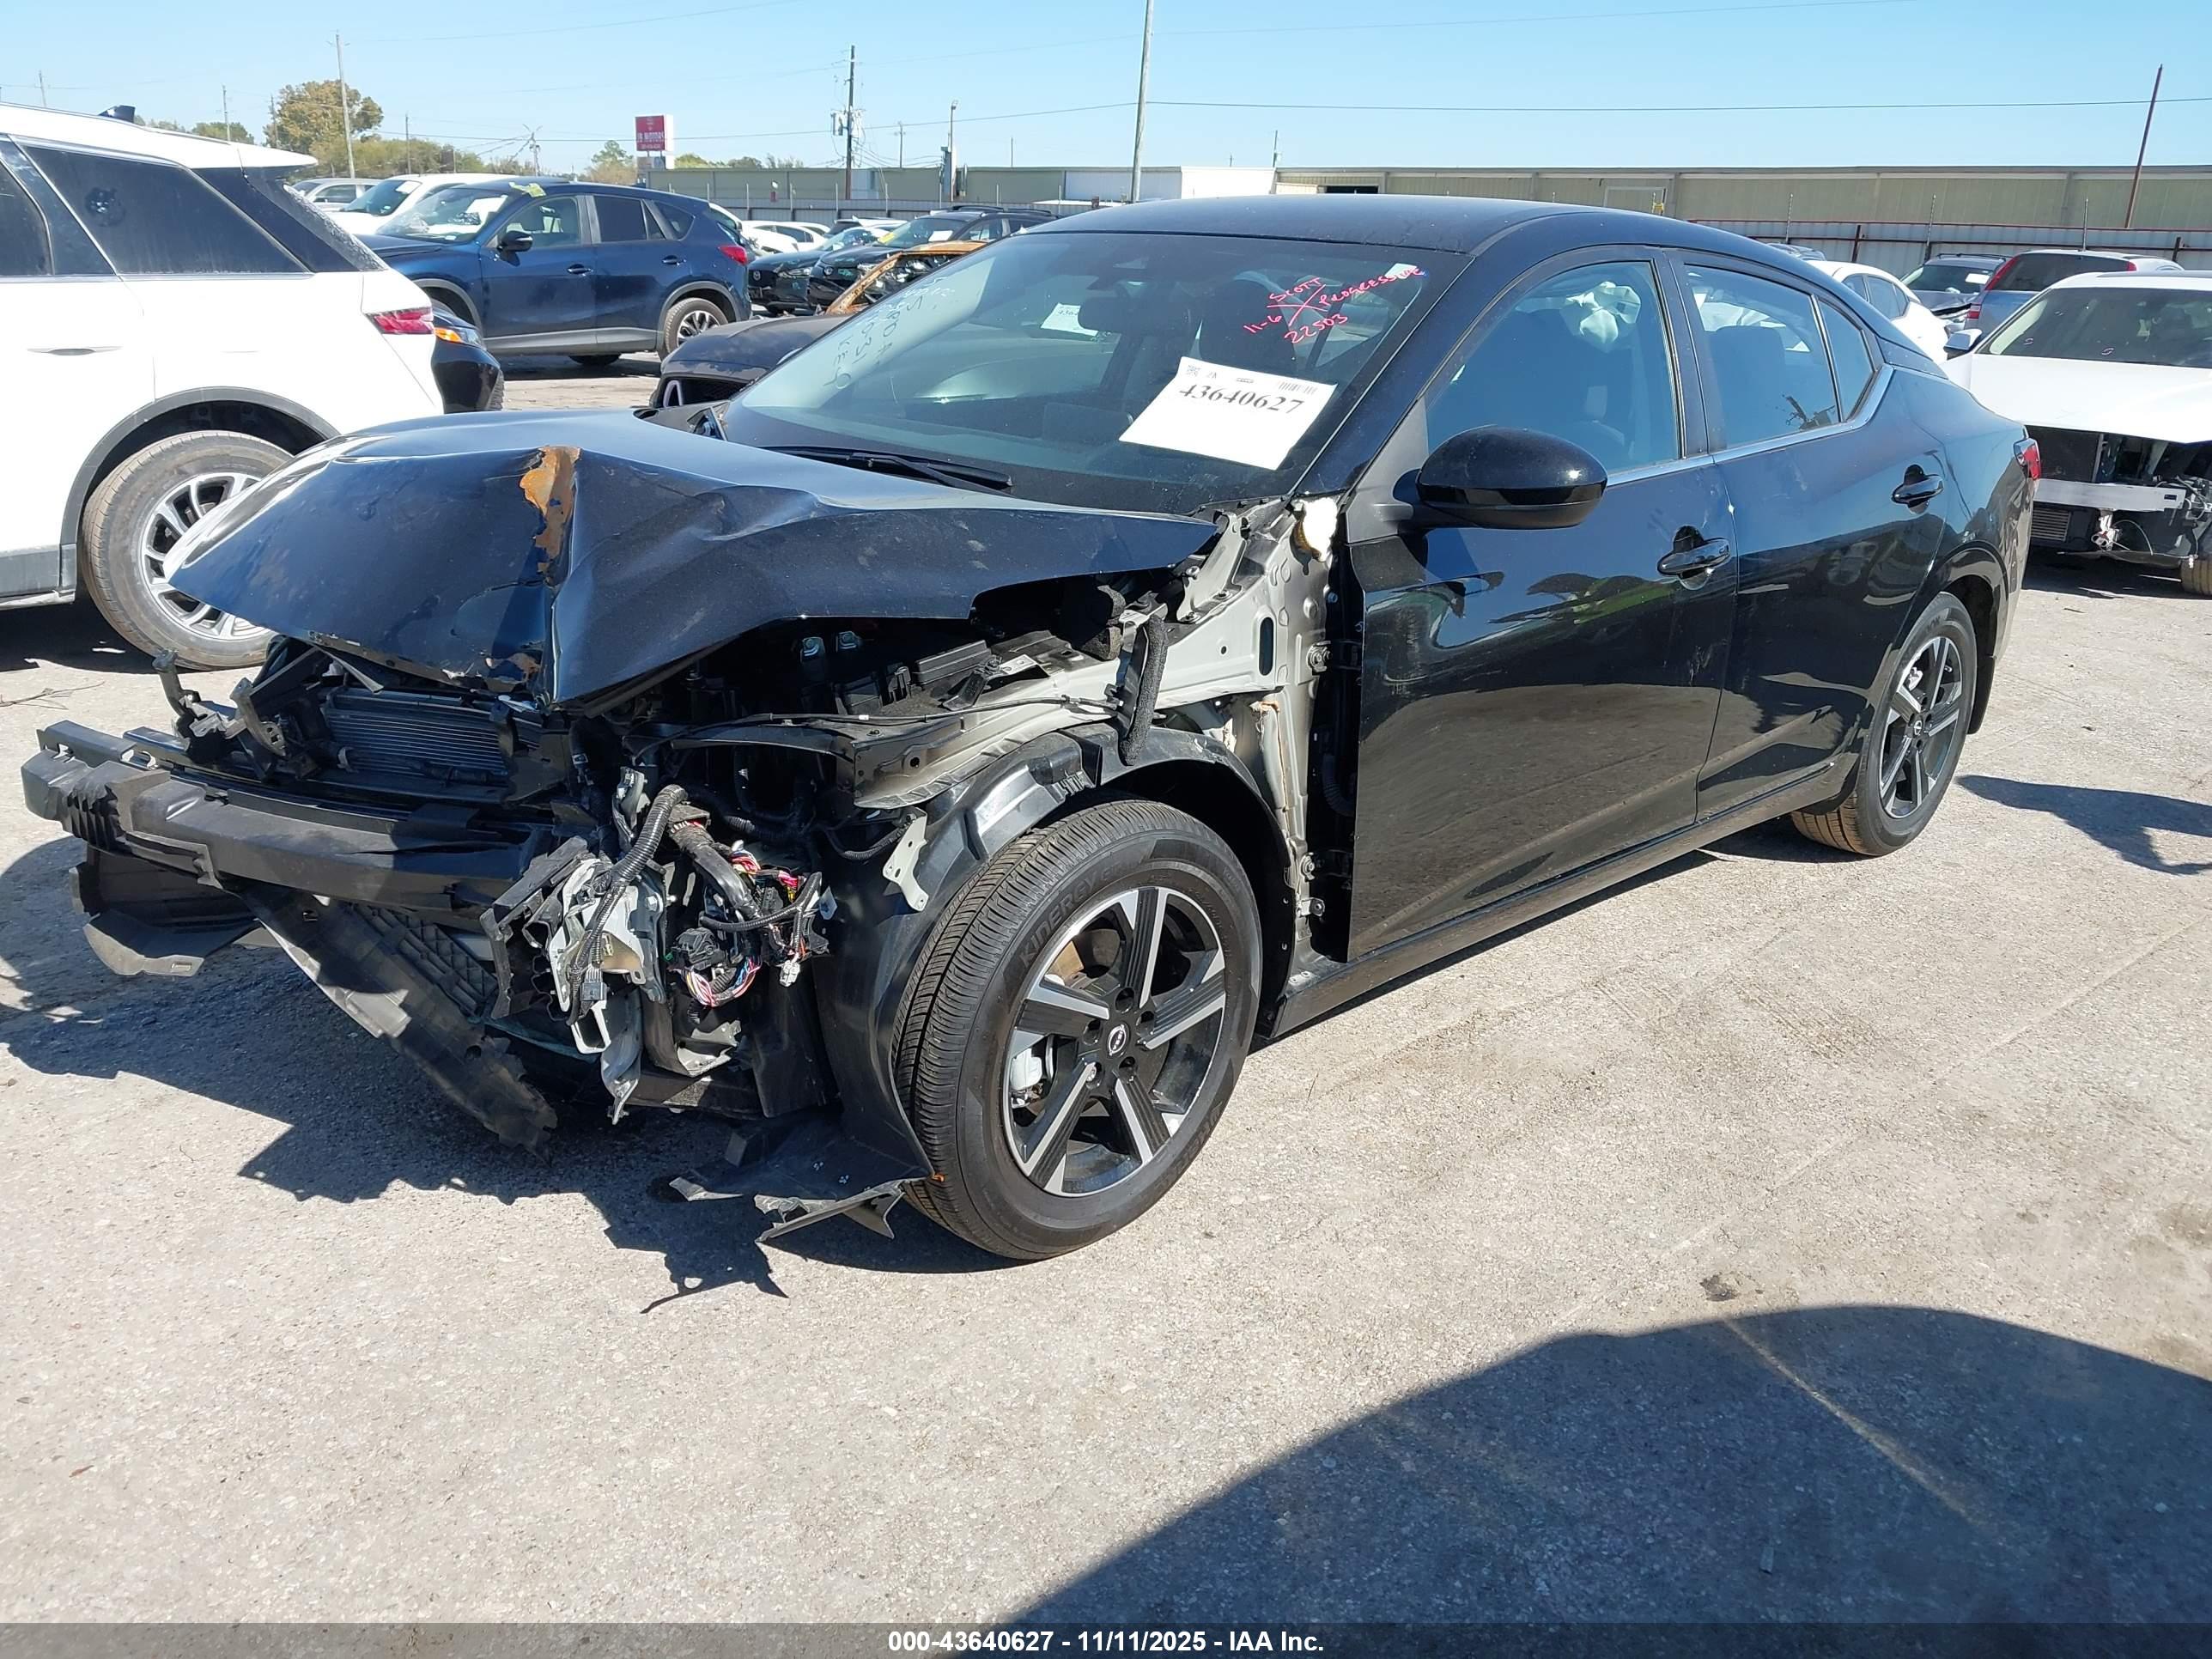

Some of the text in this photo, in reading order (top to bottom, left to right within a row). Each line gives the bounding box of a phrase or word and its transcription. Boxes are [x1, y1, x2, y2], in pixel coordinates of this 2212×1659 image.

[1269, 276, 1322, 302] SCOTT
[1284, 313, 1348, 344] 22503
[1179, 384, 1305, 414] 43640627
